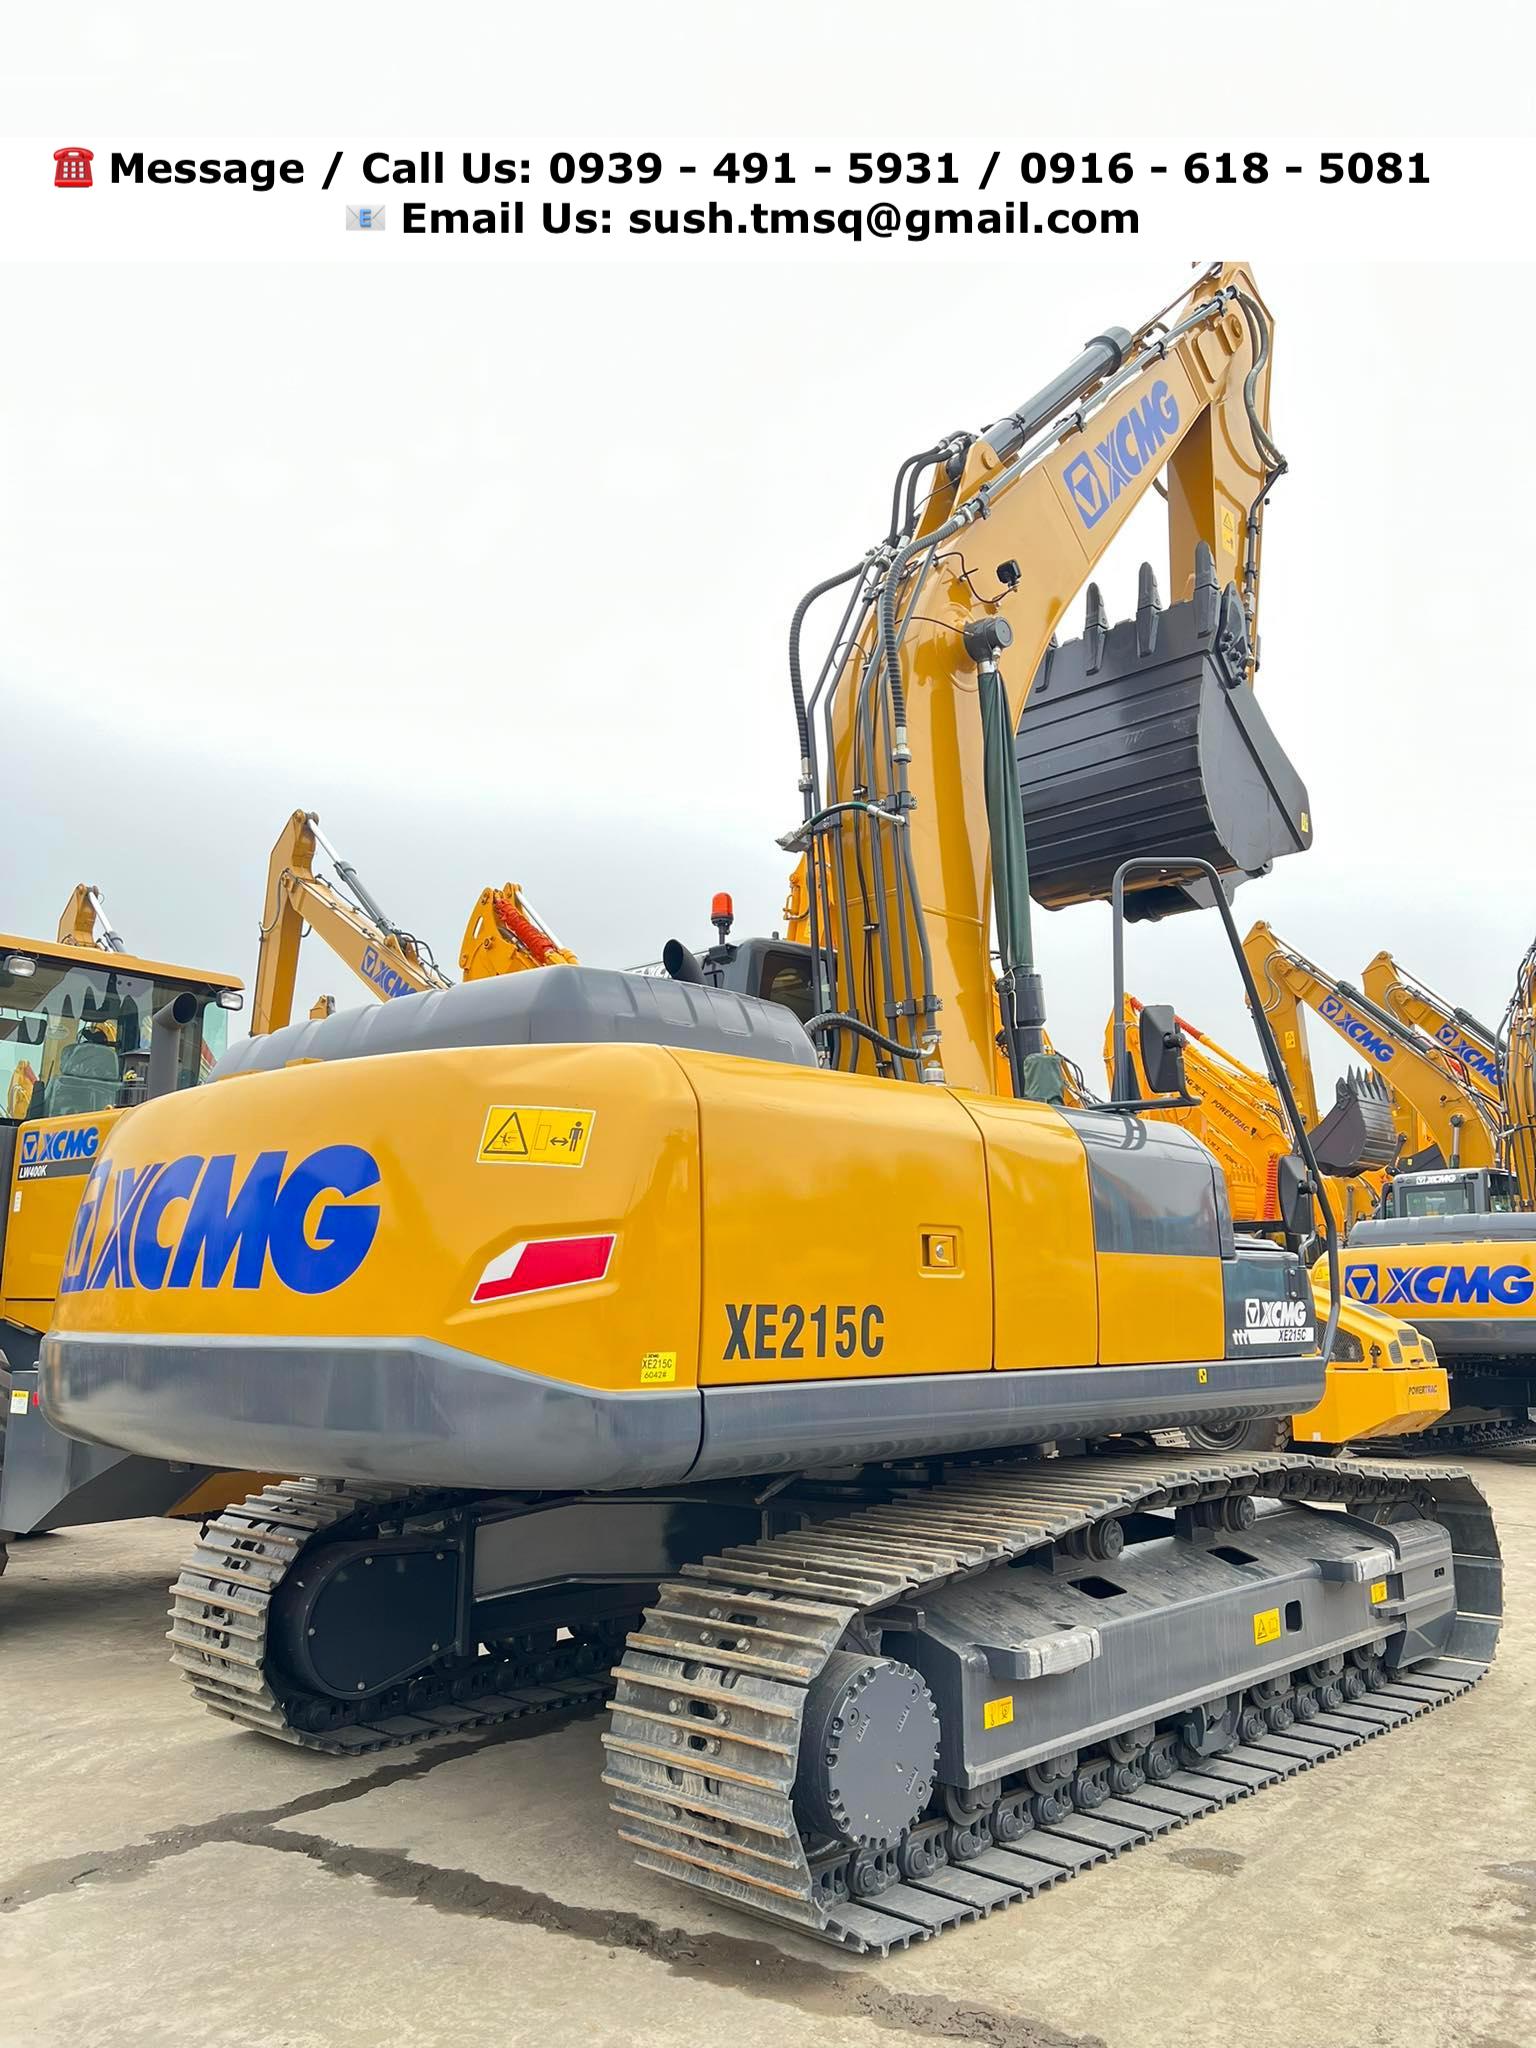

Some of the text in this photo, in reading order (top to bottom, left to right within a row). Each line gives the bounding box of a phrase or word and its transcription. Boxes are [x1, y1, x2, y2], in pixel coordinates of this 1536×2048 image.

[1094, 379, 1180, 504] XCMG
[374, 961, 418, 998] XCM
[1334, 1012, 1395, 1063] XCMG
[40, 1126, 99, 1162] XCMG
[1426, 1174, 1457, 1184] XCMG
[84, 1144, 381, 1295] XCMG
[1381, 1265, 1534, 1304] XCMG
[722, 1303, 885, 1360] XE215C
[1259, 1301, 1307, 1327] XCMG
[1278, 1329, 1307, 1342] XE215C
[642, 1358, 673, 1369] XE215C
